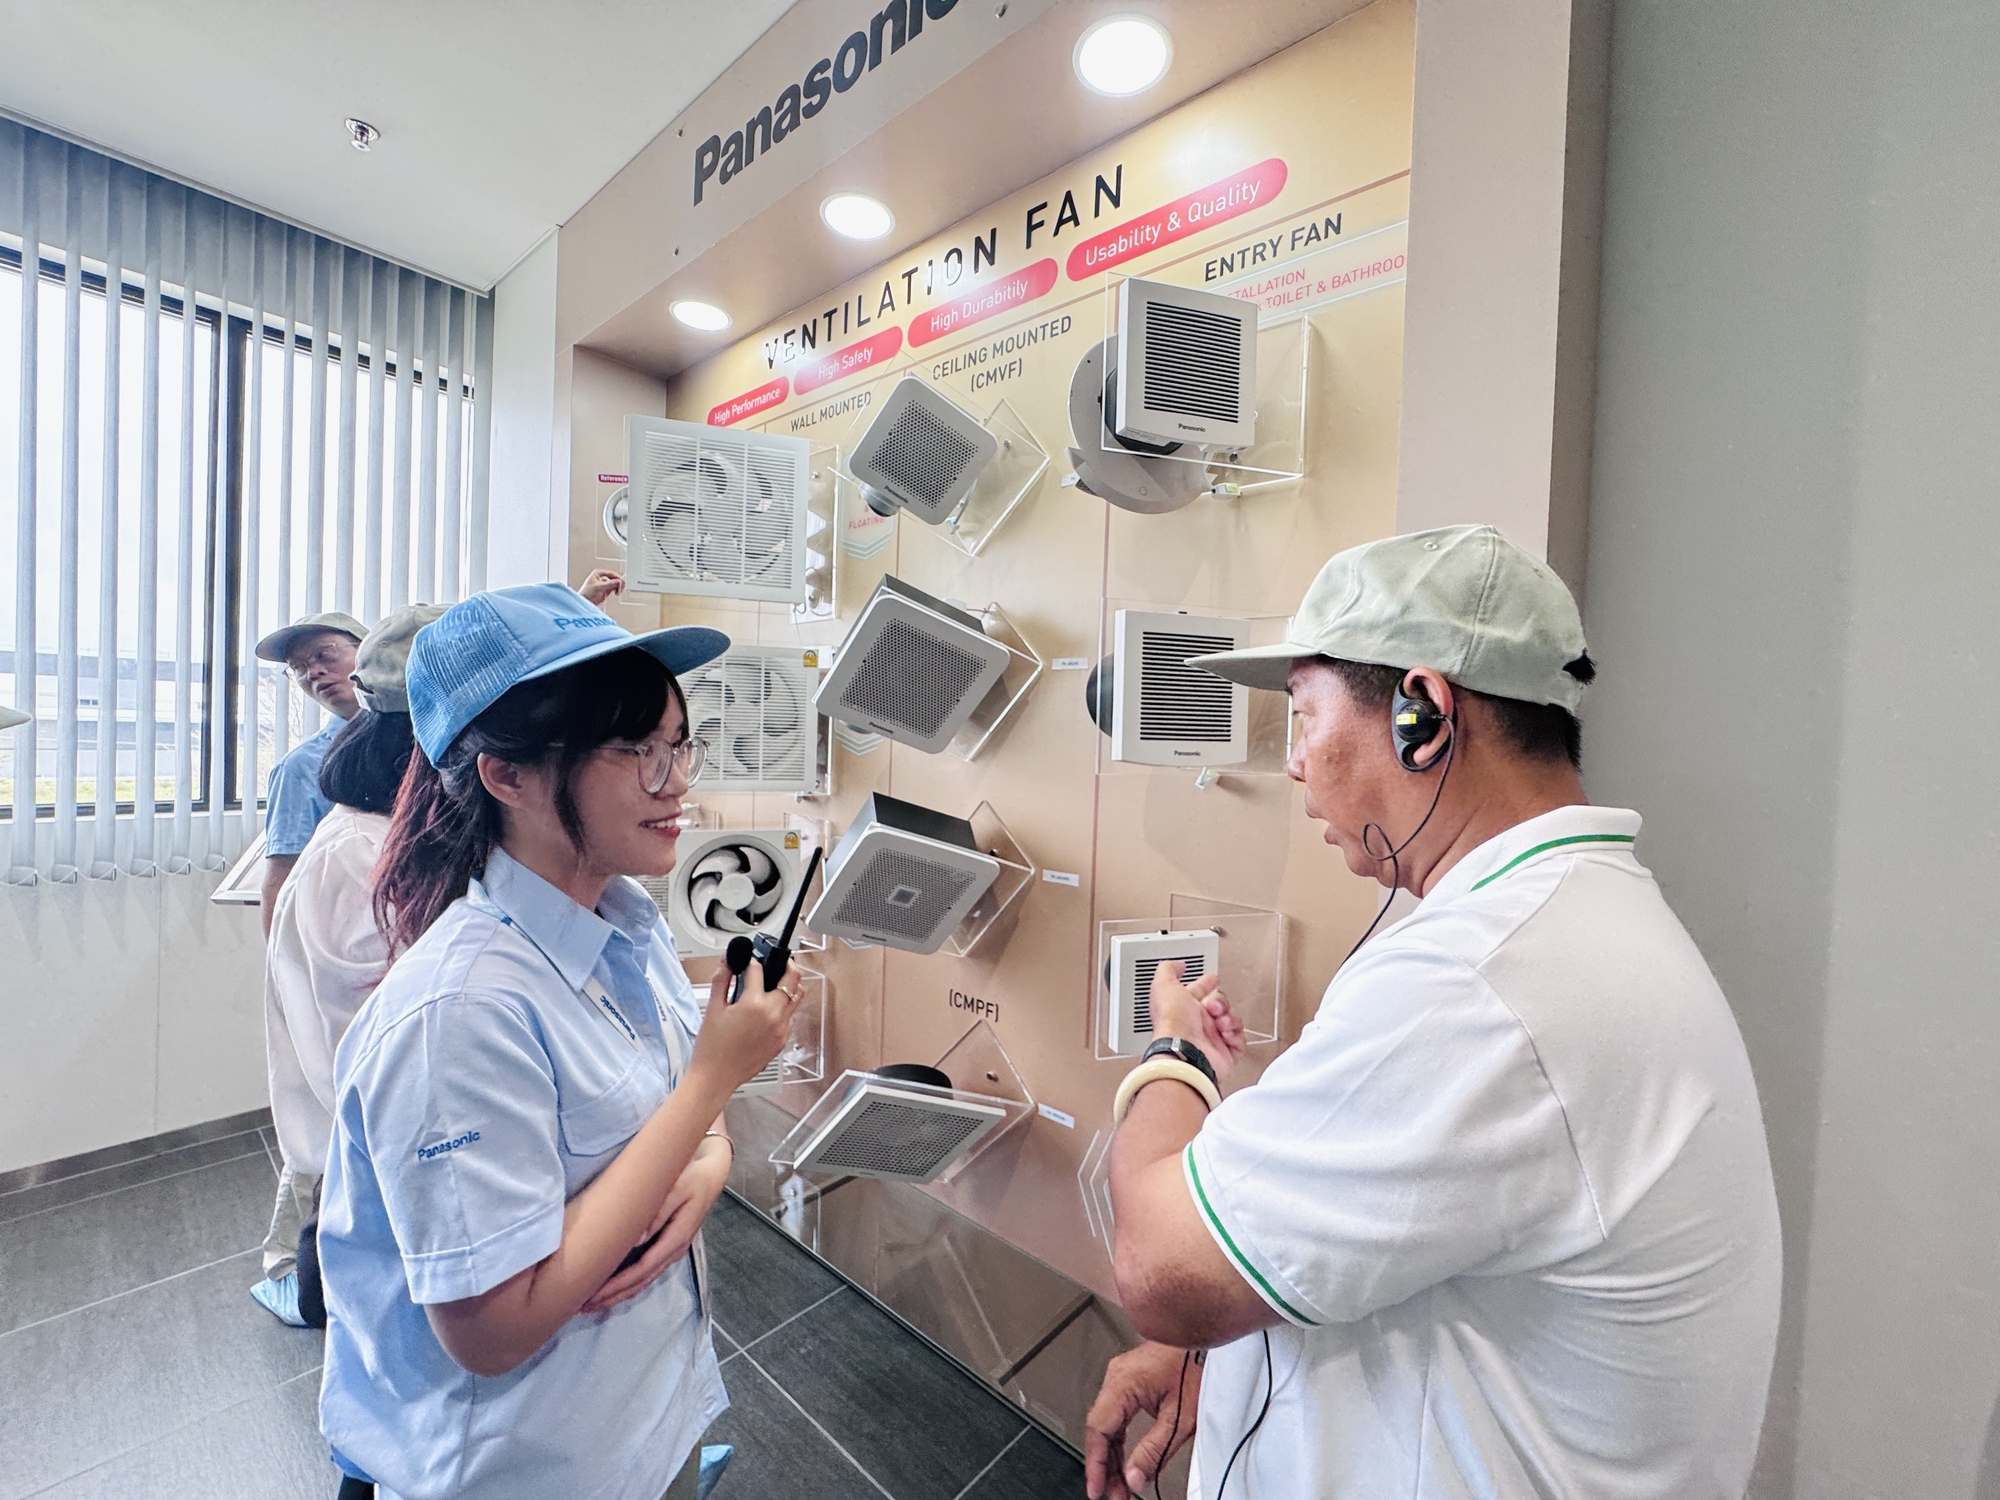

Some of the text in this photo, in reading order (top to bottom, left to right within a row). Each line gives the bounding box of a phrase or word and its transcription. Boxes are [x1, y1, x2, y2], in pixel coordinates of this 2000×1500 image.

[1085, 180, 1261, 266] Usability & Quality
[1205, 212, 1342, 282] ENTRY FAN
[765, 164, 1123, 369] VENTILATION FAN
[1227, 268, 1306, 300] TALLATION
[1265, 283, 1313, 308] TOILET
[1316, 281, 1327, 294] &
[930, 309, 958, 332] High
[818, 348, 873, 380] High Safety
[933, 315, 1072, 380] CEILING MOUNTED
[971, 358, 1023, 392] (CMVF)
[714, 387, 781, 425] High Performance
[790, 391, 872, 432] WALL MOUNTED
[1178, 422, 1206, 433] Panasonic
[599, 994, 636, 1041] Panasonic
[949, 988, 999, 1022] (CMPF)
[417, 1131, 481, 1160] Panasonic
